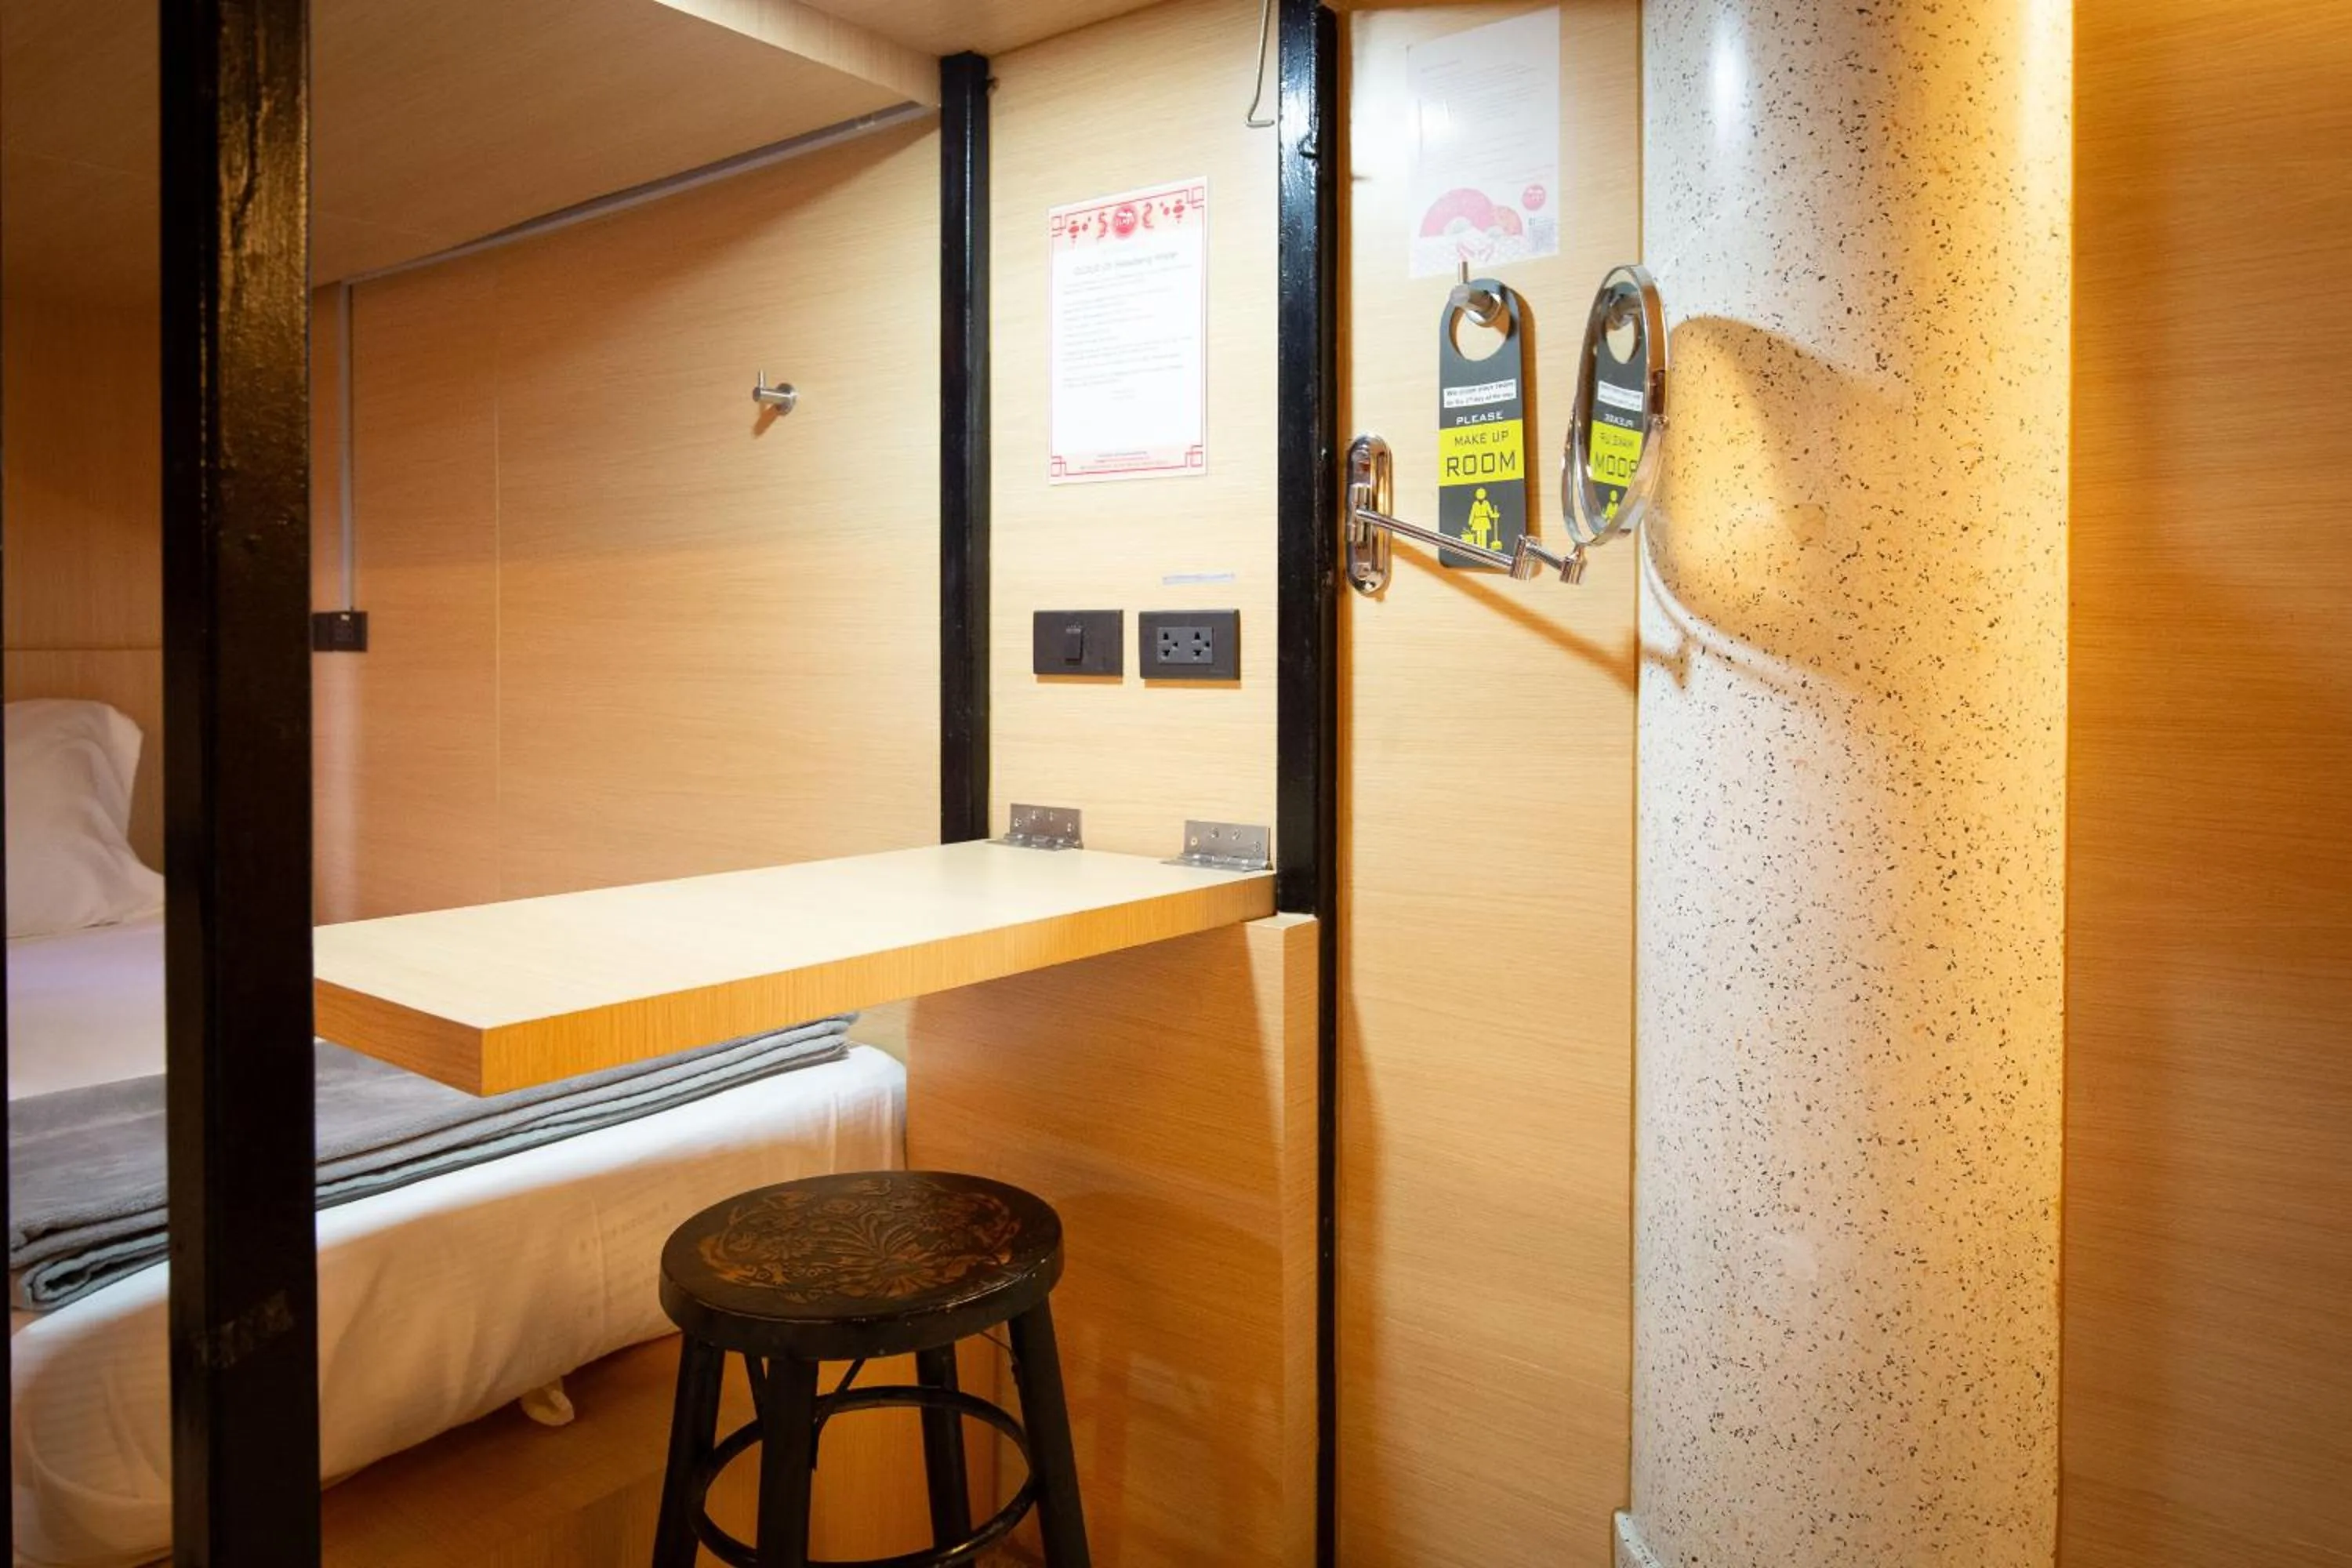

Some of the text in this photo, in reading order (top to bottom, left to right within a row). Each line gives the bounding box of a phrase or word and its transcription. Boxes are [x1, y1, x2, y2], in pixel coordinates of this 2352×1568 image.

[1456, 410, 1504, 425] PLEASE
[1455, 430, 1509, 446] MAKE UP
[1446, 451, 1515, 477] ROOM
